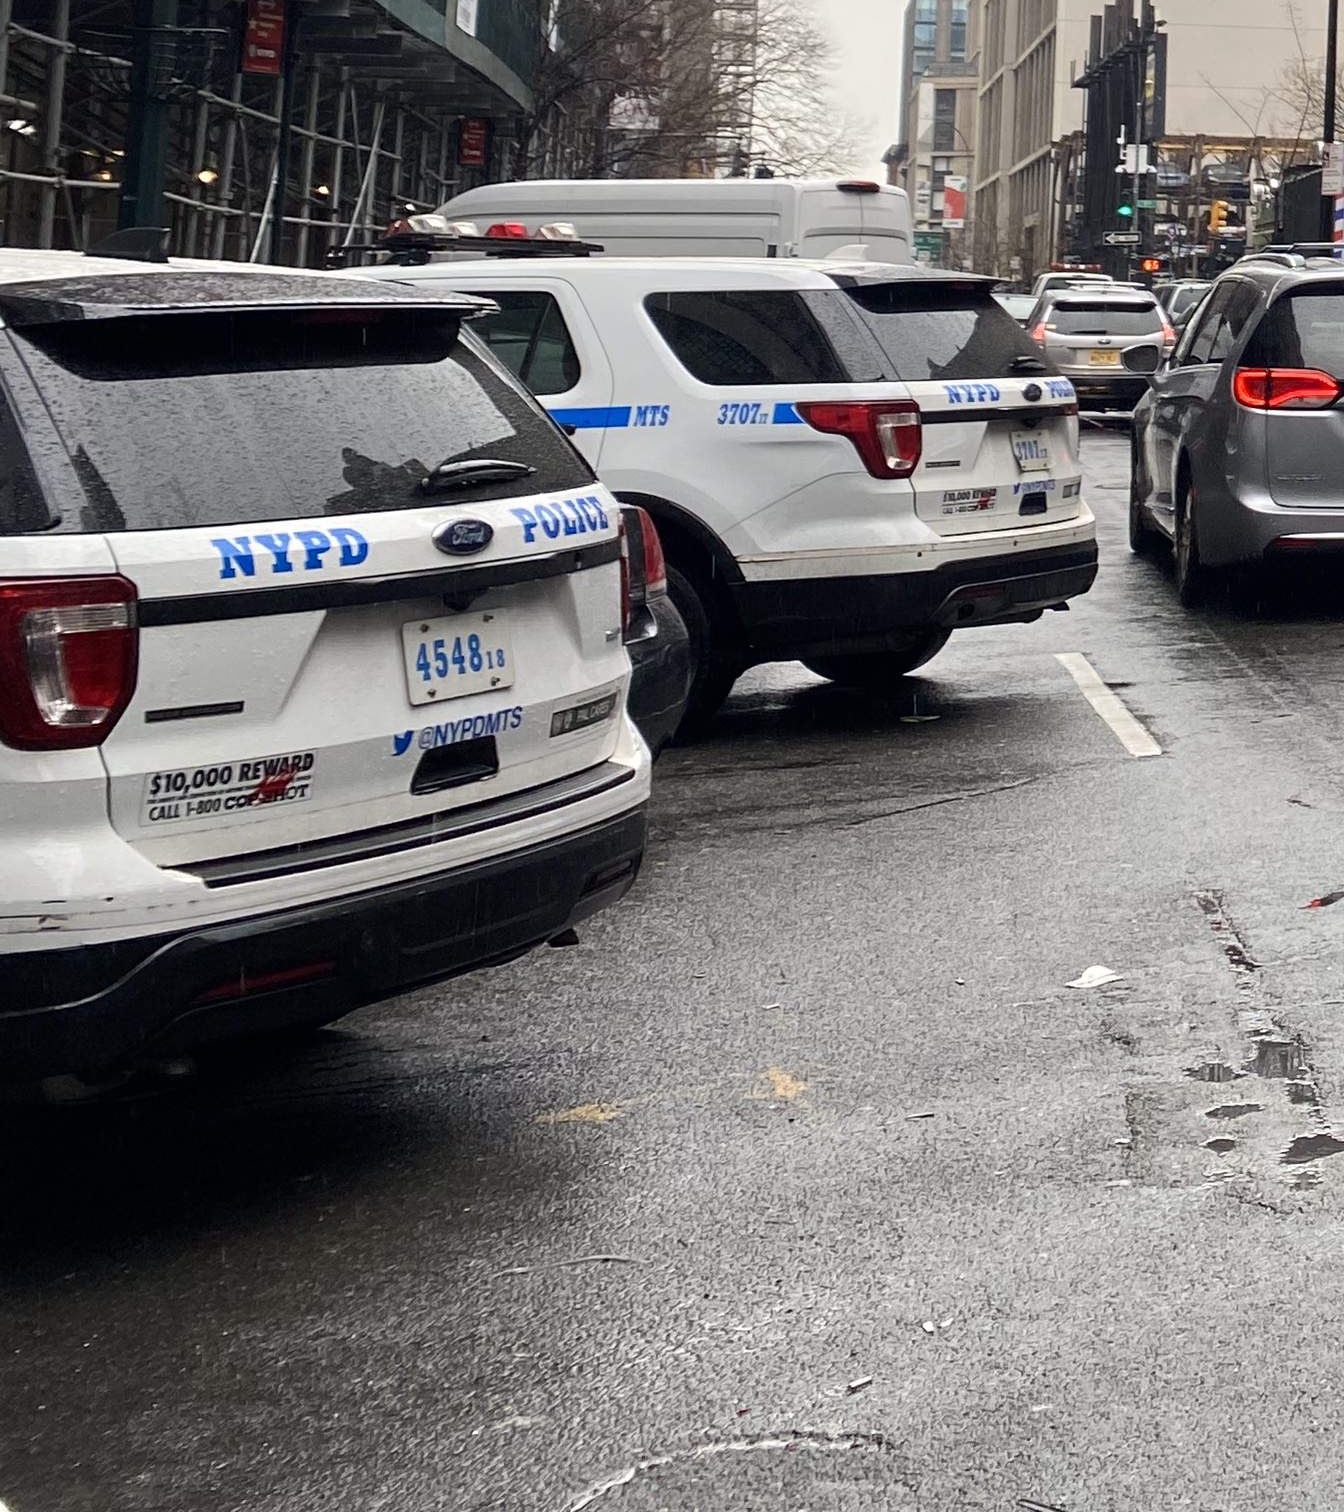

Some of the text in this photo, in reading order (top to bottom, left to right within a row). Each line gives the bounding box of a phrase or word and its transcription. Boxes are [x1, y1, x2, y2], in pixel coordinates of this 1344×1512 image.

[943, 383, 1000, 404] NYPD
[633, 405, 670, 427] MTS
[717, 402, 761, 425] 3707
[211, 496, 610, 579] NYPD Ford POLICE
[416, 633, 505, 682] 4548 18
[418, 705, 524, 750] @NYPDMTS
[150, 765, 232, 797] $10,000
[238, 753, 314, 783] REWARD
[149, 801, 180, 822] CALL
[186, 797, 221, 817] 1-800
